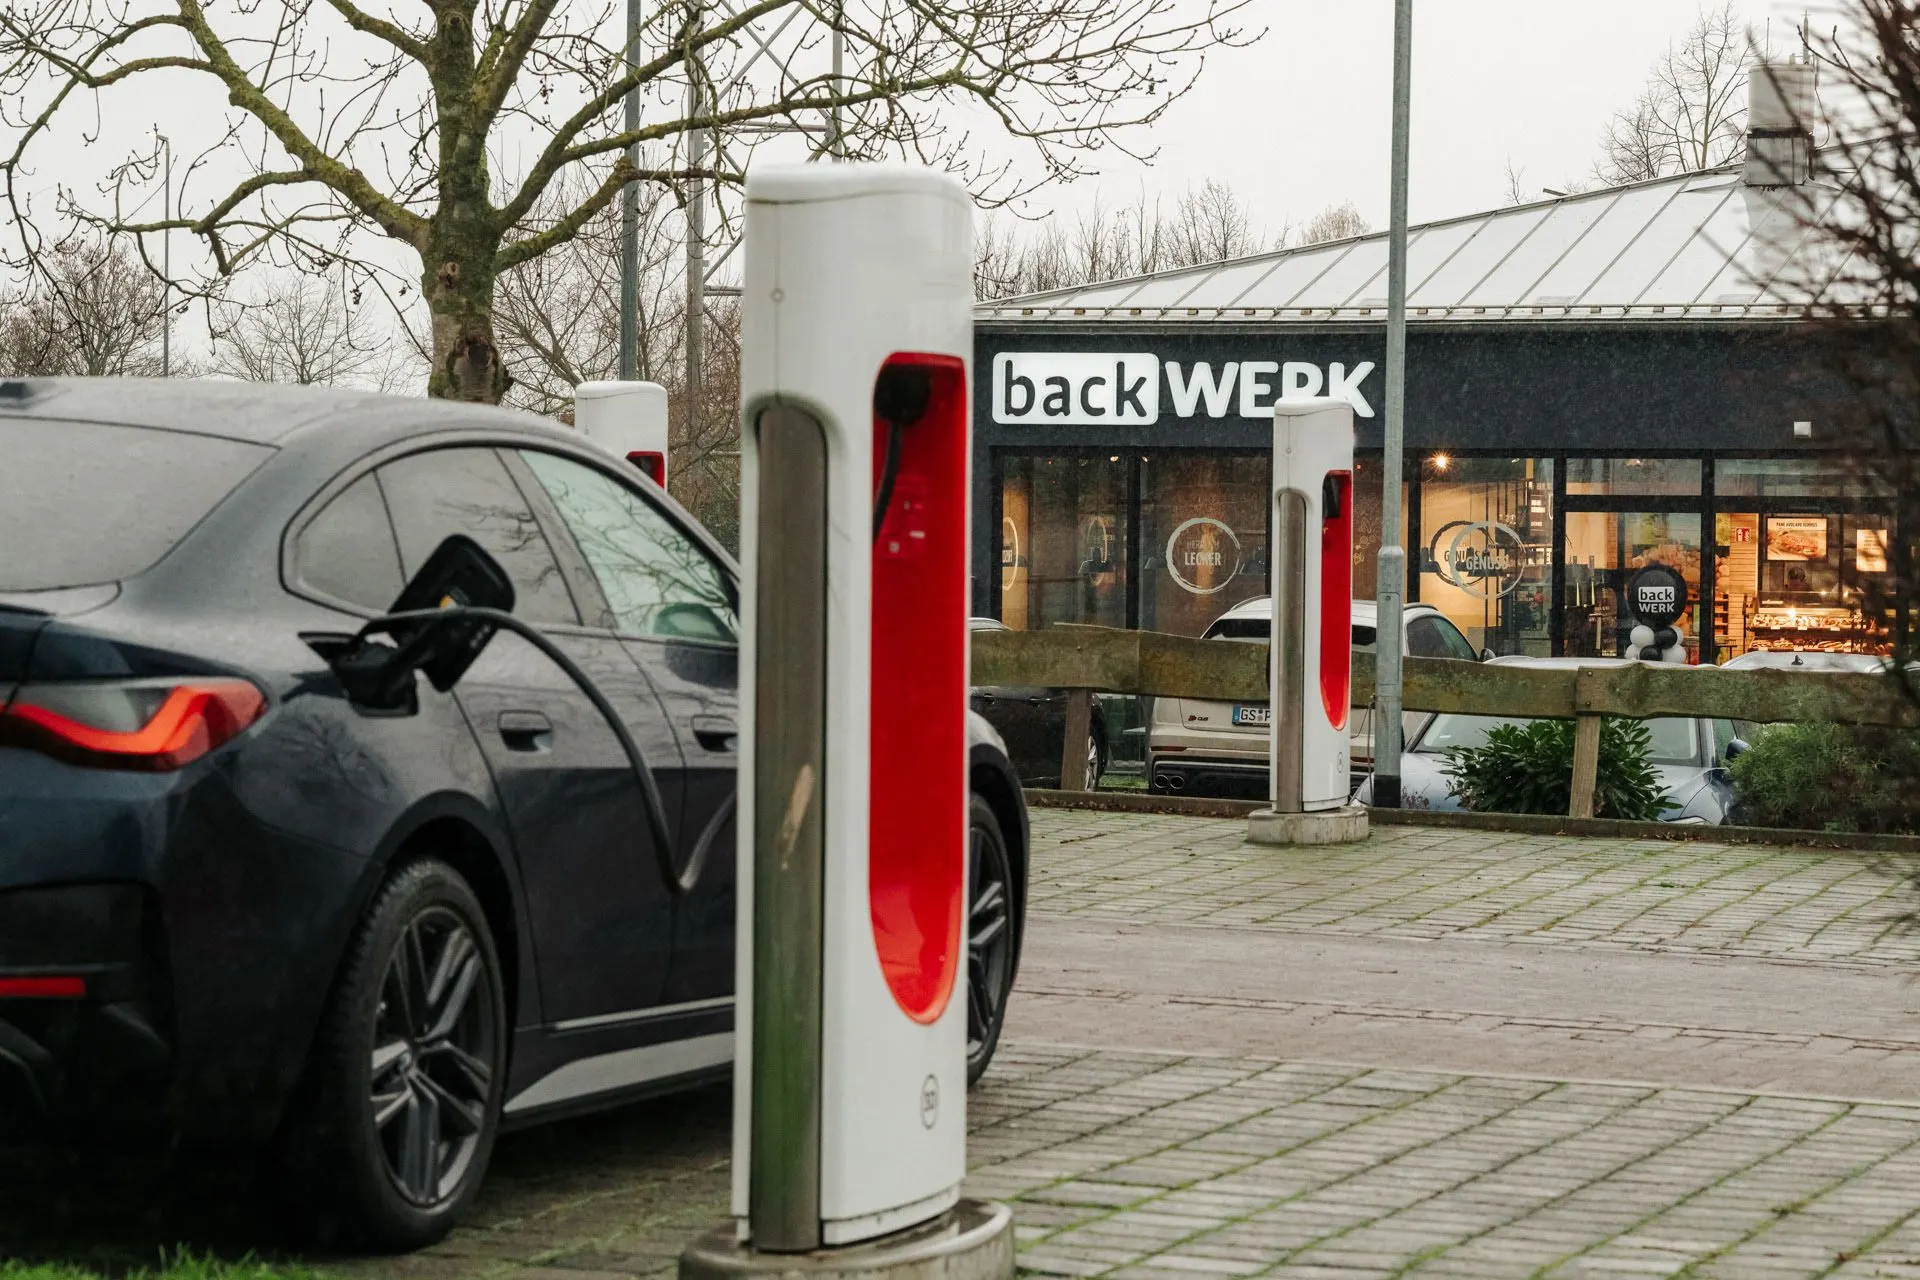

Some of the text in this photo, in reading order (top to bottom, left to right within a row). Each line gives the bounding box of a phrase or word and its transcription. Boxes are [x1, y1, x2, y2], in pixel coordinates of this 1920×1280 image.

[1004, 359, 1148, 418] back
[1640, 588, 1673, 601] back
[1638, 602, 1675, 613] WERK
[1241, 709, 1256, 721] GS
